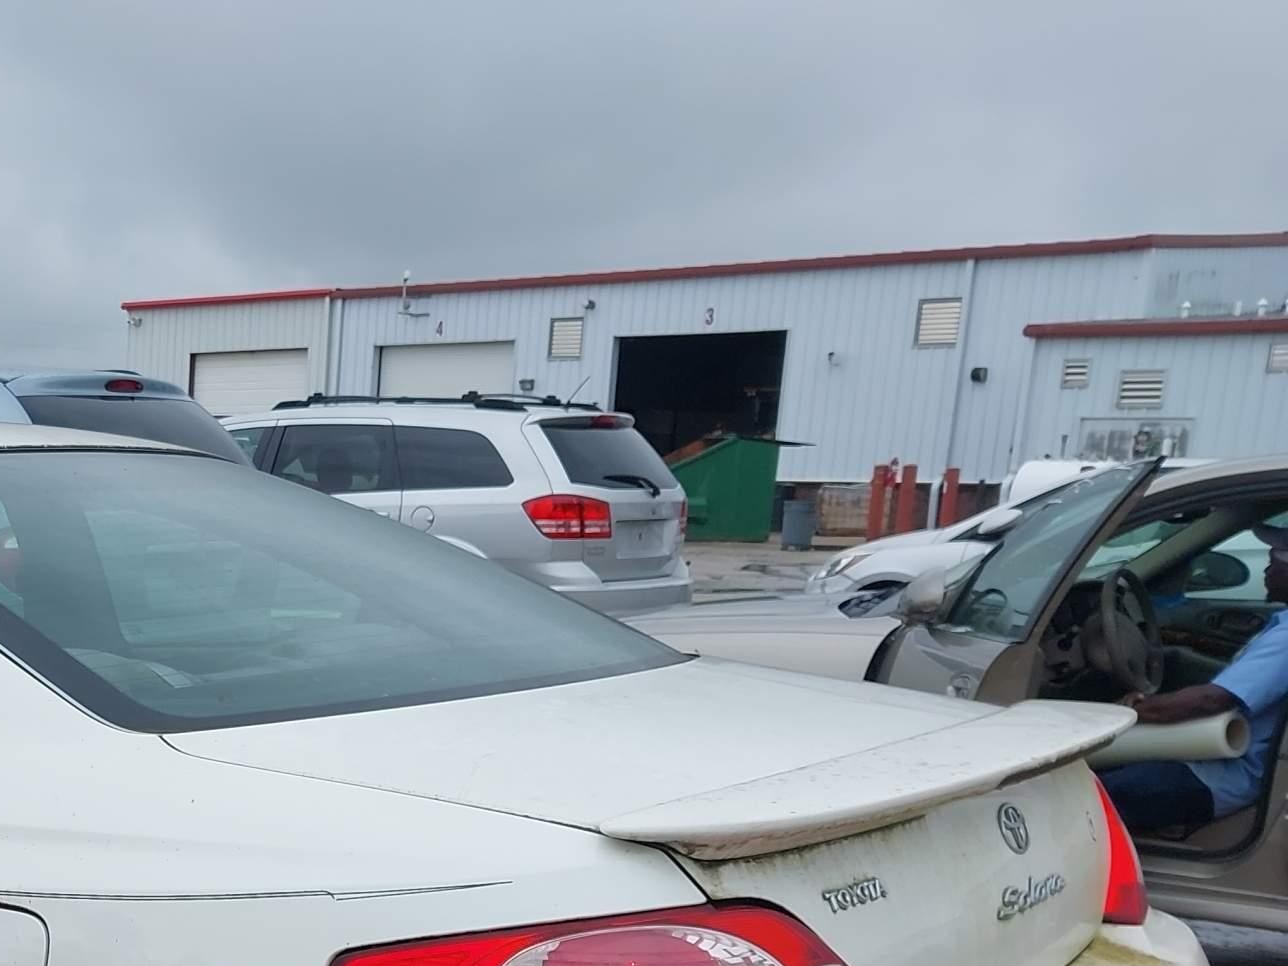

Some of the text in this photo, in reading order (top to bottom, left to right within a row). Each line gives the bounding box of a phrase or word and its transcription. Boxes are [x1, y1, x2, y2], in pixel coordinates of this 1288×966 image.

[435, 320, 444, 337] 4
[705, 307, 715, 326] 3
[822, 877, 888, 914] TOYOTA
[996, 873, 1066, 921] Solara
